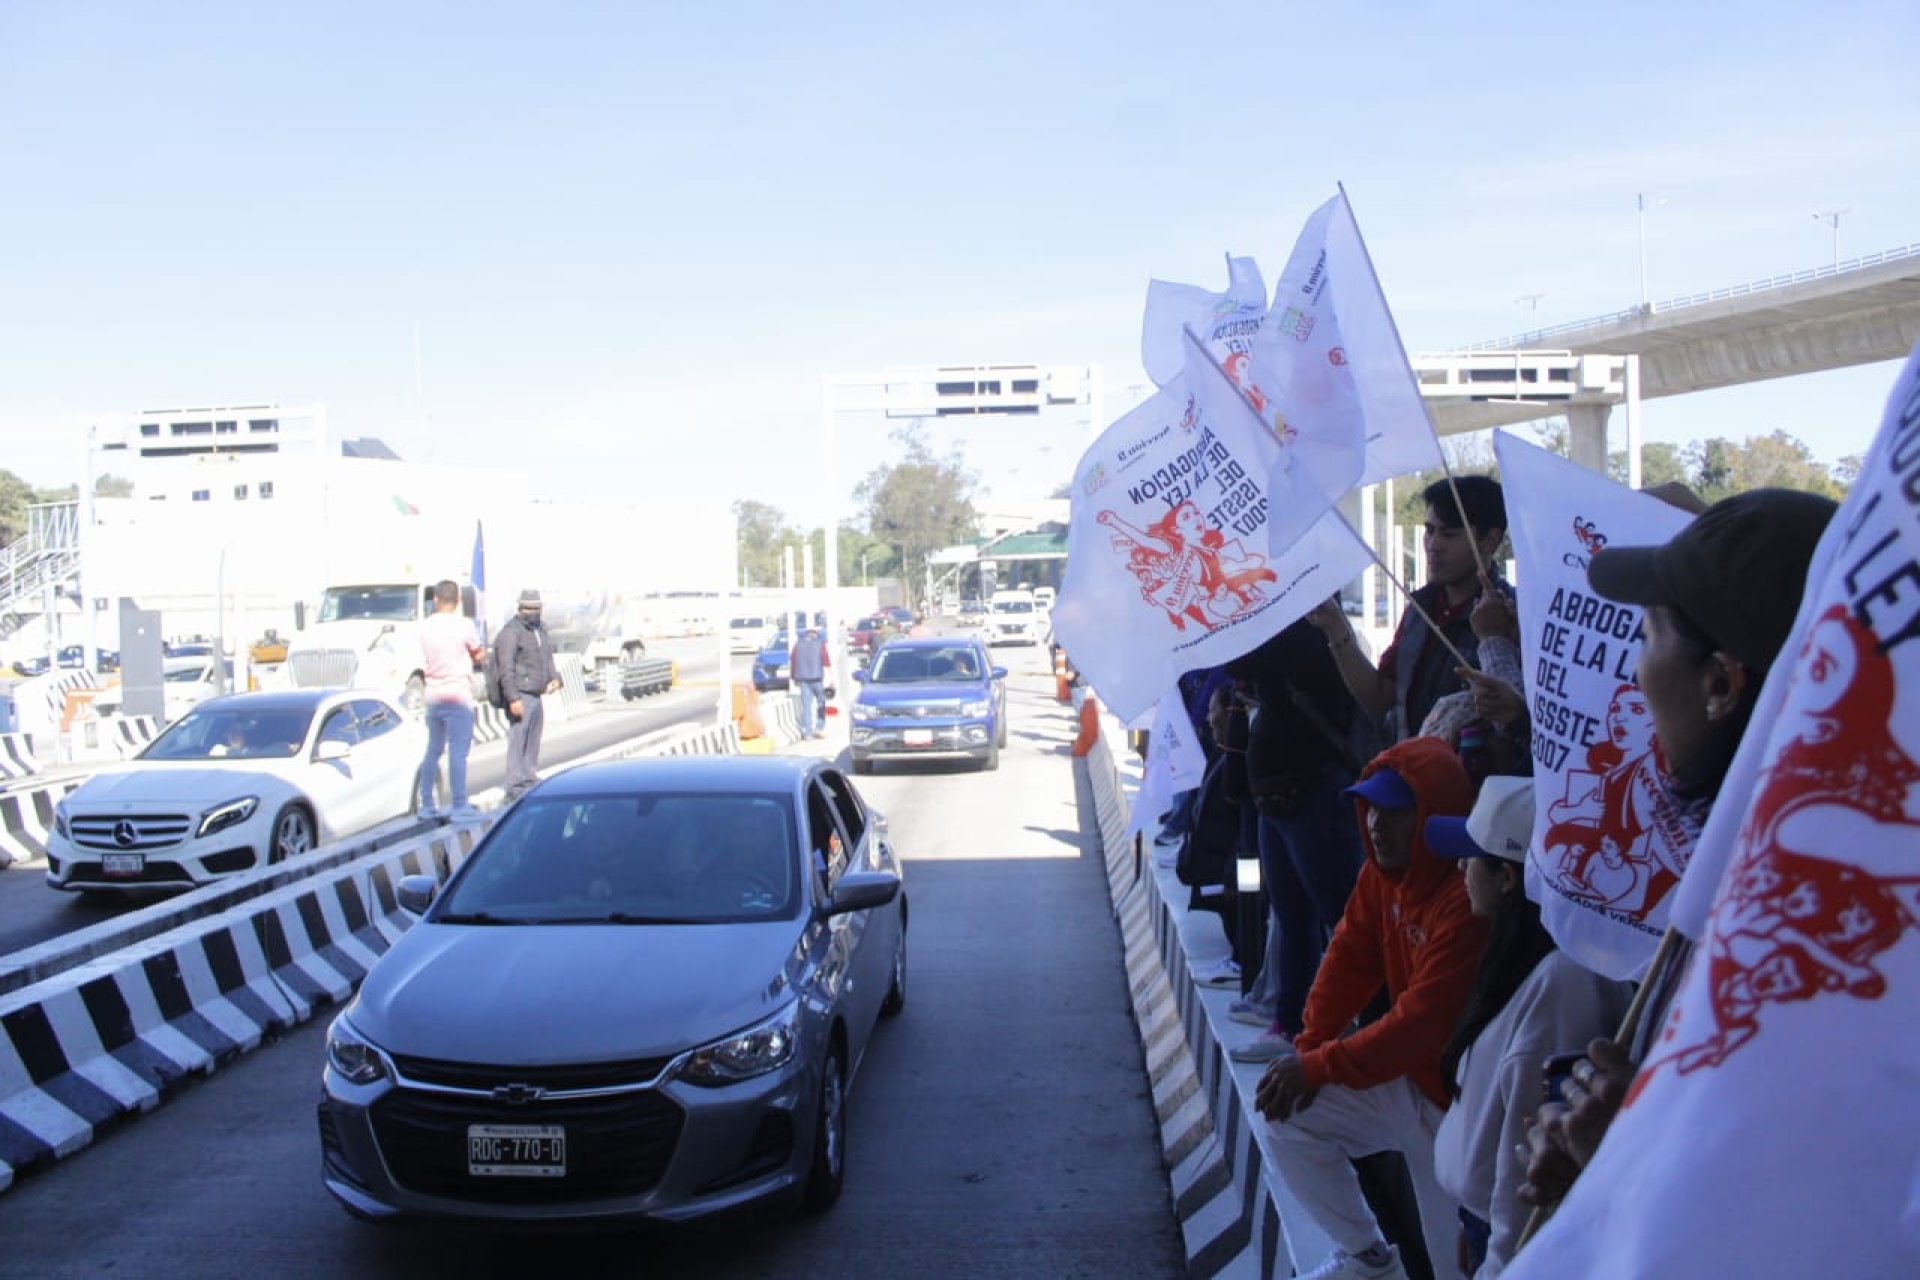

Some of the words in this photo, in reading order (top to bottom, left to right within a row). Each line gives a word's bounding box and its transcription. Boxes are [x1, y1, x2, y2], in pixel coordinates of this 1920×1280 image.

[1541, 620, 1570, 658] DE
[1572, 634, 1607, 673] LA
[1614, 648, 1639, 685] L
[1536, 656, 1568, 699] DEL
[472, 1138, 561, 1162] RDG-770-D
